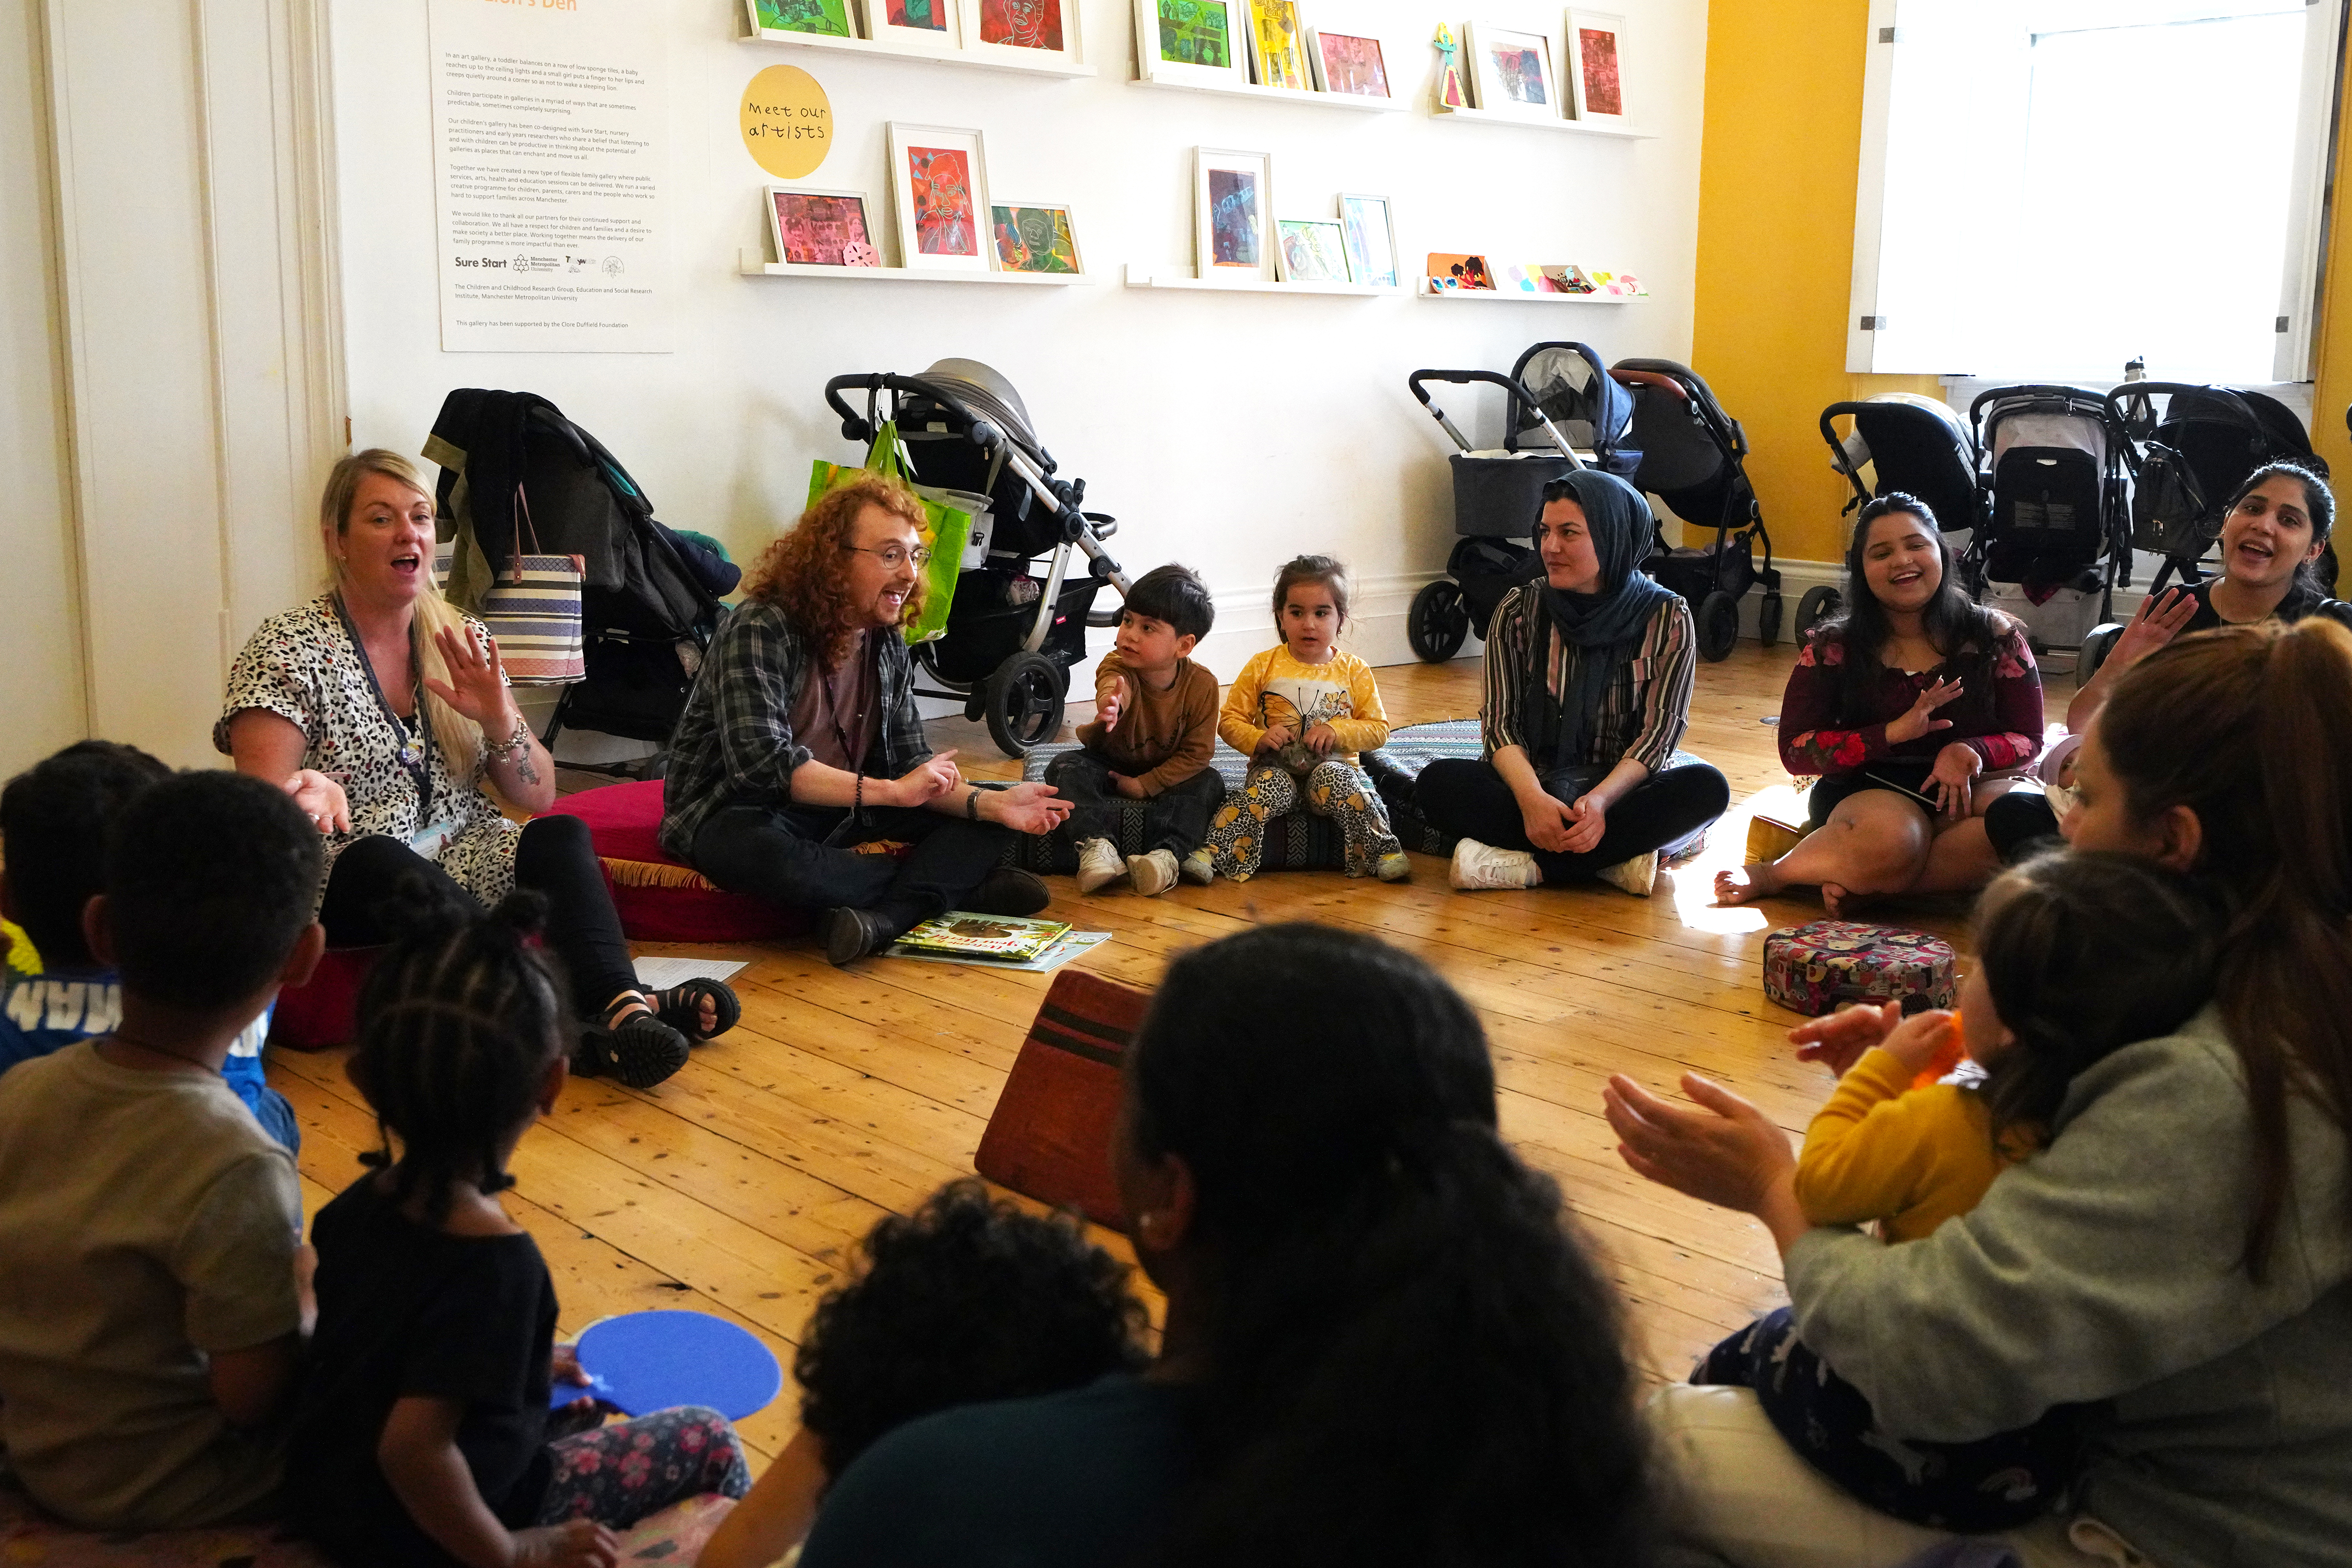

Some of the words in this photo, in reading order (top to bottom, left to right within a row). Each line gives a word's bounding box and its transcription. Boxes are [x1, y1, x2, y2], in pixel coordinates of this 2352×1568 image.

[471, 54, 492, 63] gallery,
[583, 83, 606, 91] sleeping
[513, 105, 543, 113] completely
[749, 102, 792, 117] Meet
[801, 108, 826, 119] our
[749, 122, 824, 139] artists
[455, 257, 479, 267] Sure
[482, 258, 507, 268] Start
